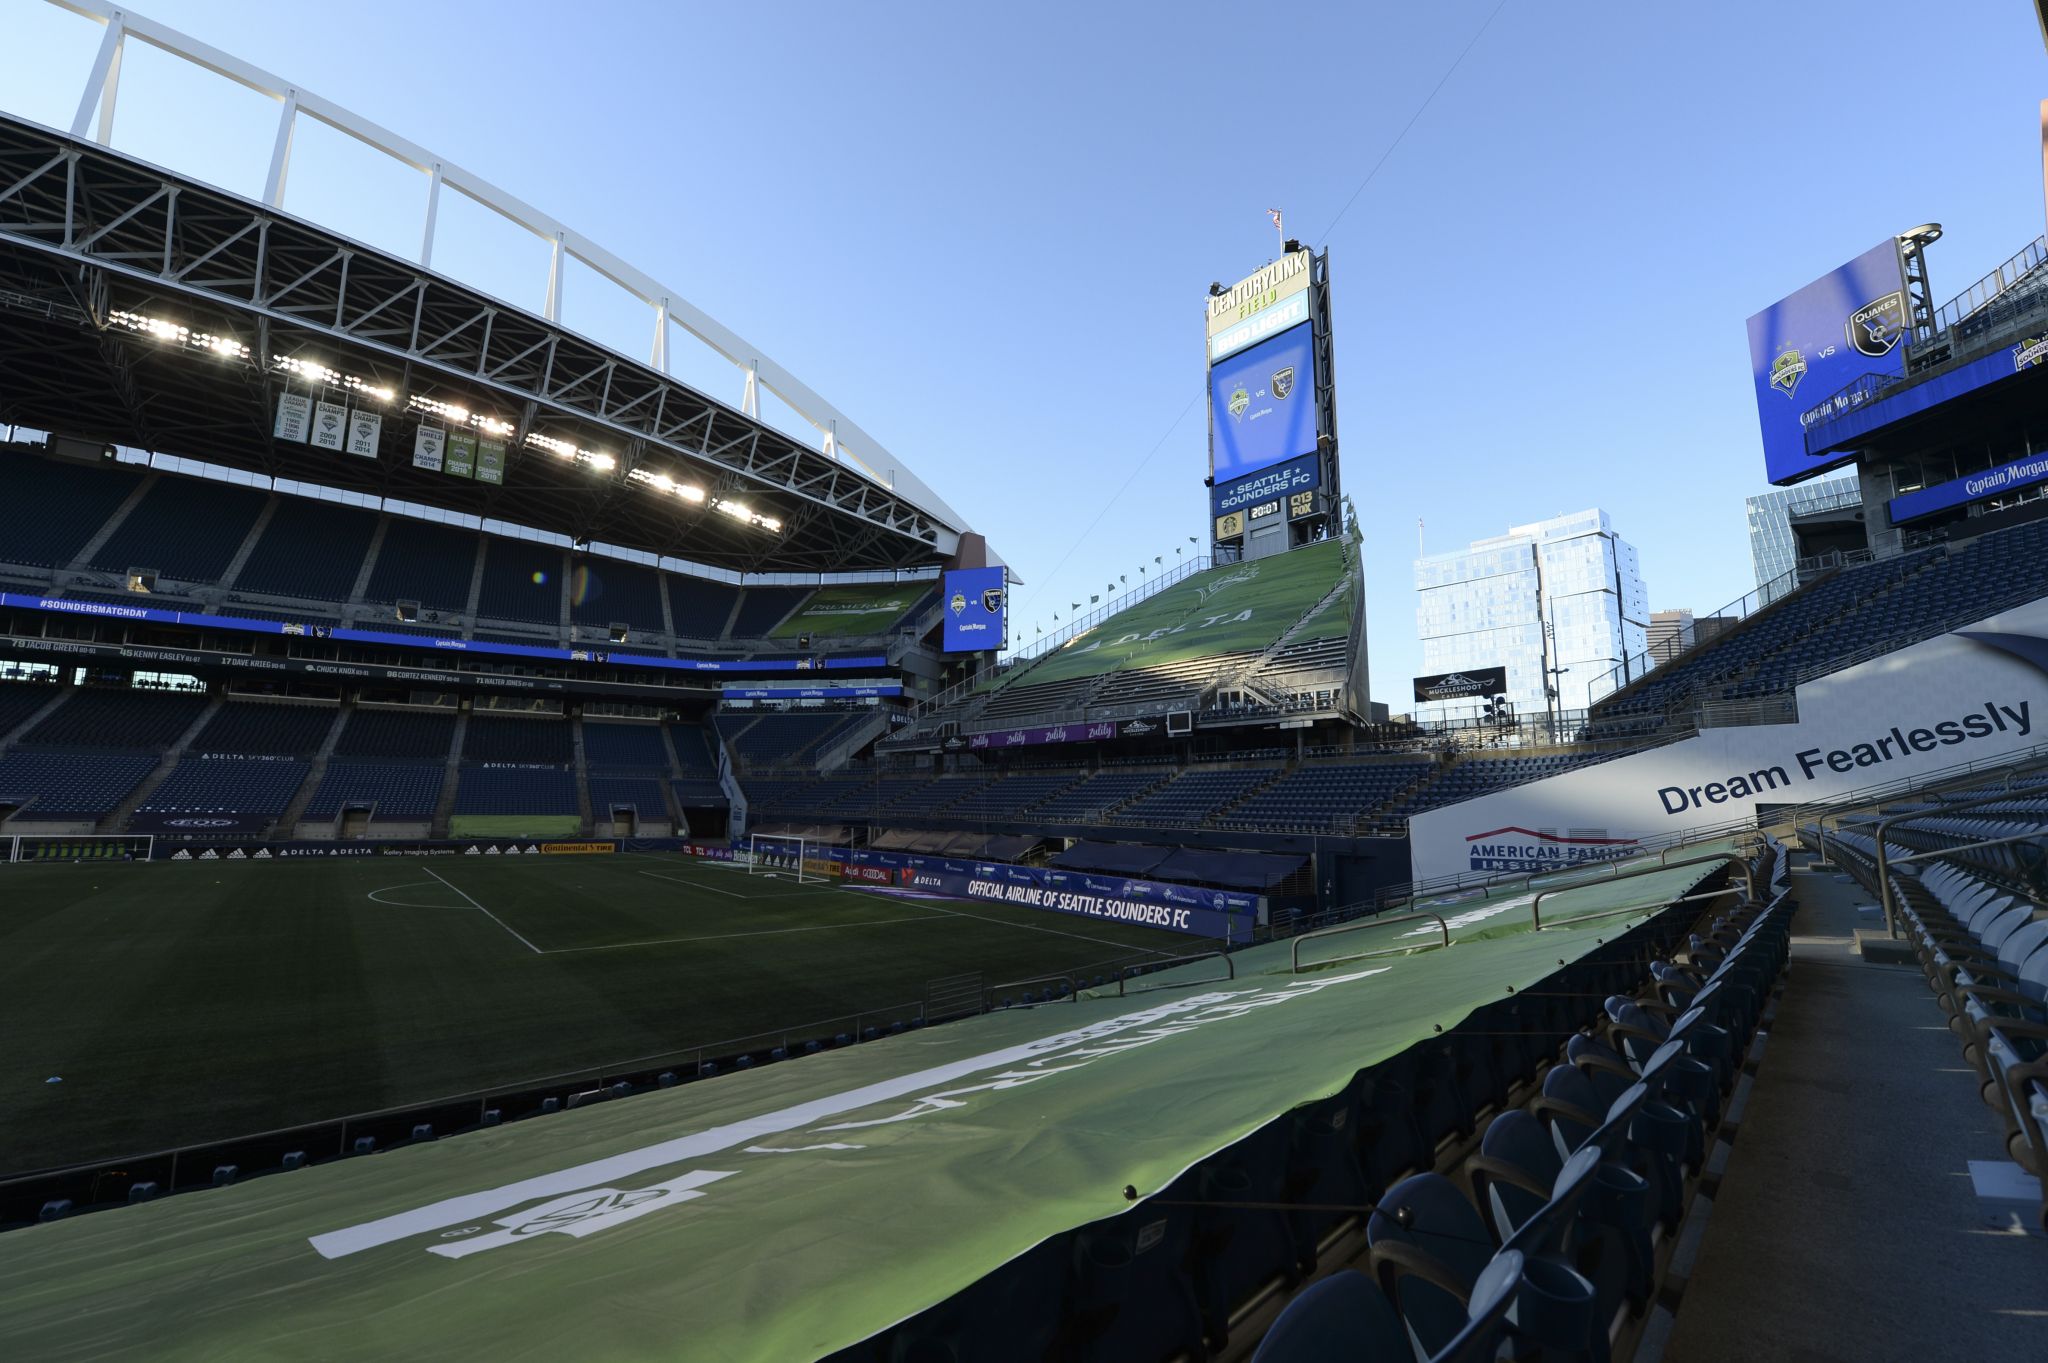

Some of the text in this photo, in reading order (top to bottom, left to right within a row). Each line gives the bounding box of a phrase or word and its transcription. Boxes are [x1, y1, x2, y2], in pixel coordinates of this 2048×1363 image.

[1211, 251, 1307, 318] CENTURYLINK
[1239, 288, 1277, 319] FIELD
[1855, 299, 1898, 324] QUAKES
[1217, 301, 1300, 354] BUD LIGHT
[319, 407, 345, 417] CHAMPS
[353, 414, 379, 425] CHAMPS
[319, 432, 337, 440] 2009
[419, 430, 443, 441] SHIELD
[318, 437, 336, 446] 2010
[355, 439, 371, 447] 2011
[354, 445, 370, 453] 2014
[415, 453, 441, 464] CHAMPS
[447, 459, 472, 470] CHAMPS
[1236, 468, 1292, 495] SEATTLE
[1965, 472, 2006, 496] Captain
[1221, 473, 1311, 509] SOUNDERS FC
[1291, 491, 1313, 507] Q13
[1251, 501, 1278, 519] 20:07
[1292, 503, 1312, 518] FOX
[40, 599, 148, 618] #SOUNDERSMATCHDAY
[1111, 608, 1254, 647] DELTA
[26, 641, 52, 650] JACOB
[53, 643, 79, 652] GREEN
[133, 650, 159, 660] KENNY
[159, 652, 186, 662] EASLEY
[221, 657, 232, 665] 17
[232, 658, 250, 667] DAVE
[250, 660, 272, 669] KRIEG
[316, 665, 338, 674] CHUCK
[338, 667, 356, 675] KNOX
[397, 671, 420, 680] CORTEZ
[420, 673, 447, 682] KENNEDY
[476, 677, 484, 685] 71
[484, 677, 505, 686] WALTER
[505, 679, 522, 687] JONES
[1428, 683, 1483, 696] MUCKLESHOOT
[1657, 700, 2031, 815] Dream Fearlessly
[403, 849, 429, 857] Imaging
[429, 848, 455, 856] Systems
[544, 844, 588, 853] Continental
[683, 846, 692, 854] TCL
[696, 846, 705, 856] TCL
[1470, 844, 1560, 860] AMERICAN
[919, 876, 942, 887] DELTA
[968, 880, 1191, 930] OFFICIAL AIRLINE OF SEATTLE SOUNDERS FC
